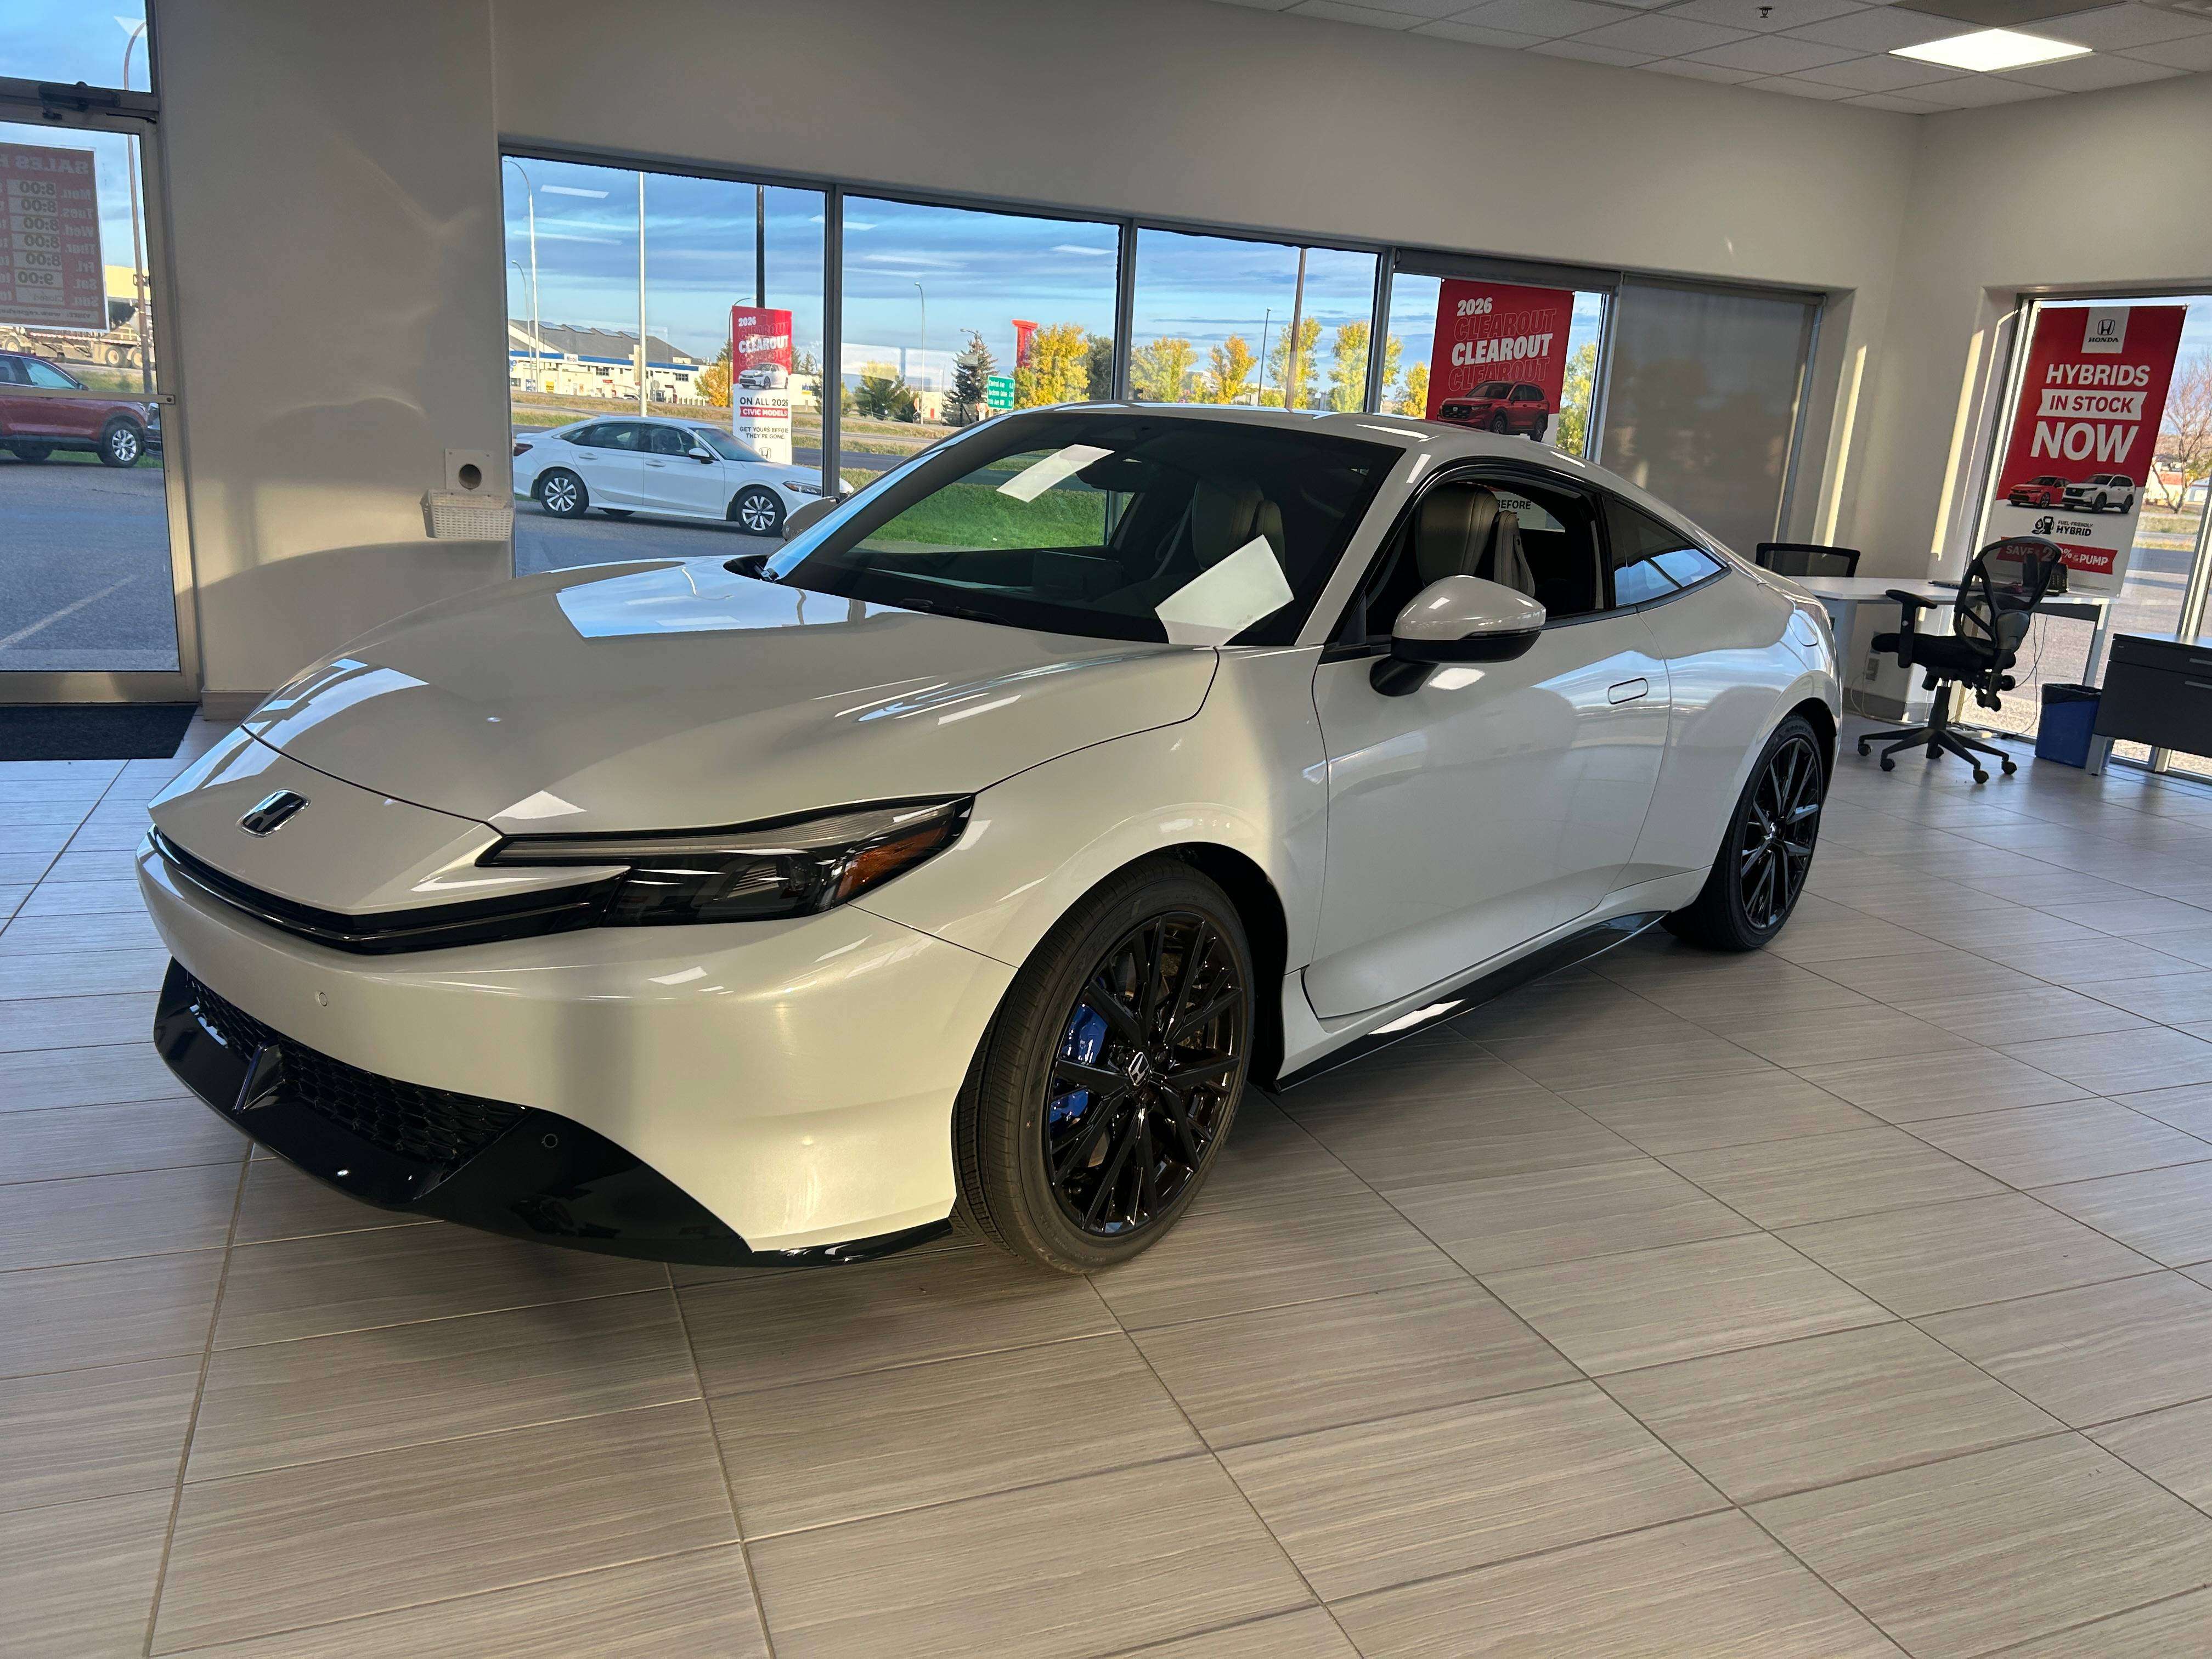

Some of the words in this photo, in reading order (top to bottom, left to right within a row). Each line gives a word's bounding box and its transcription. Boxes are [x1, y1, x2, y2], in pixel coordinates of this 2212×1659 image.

[1457, 297, 1493, 317] 2026
[738, 316, 757, 328] 2026
[1454, 308, 1557, 342] CLEAROUT
[738, 335, 789, 353] CLEAROUT
[1451, 333, 1553, 366] CLEAROUT
[1448, 357, 1550, 392] CLEAROUT
[2046, 364, 2151, 386] HYBRIDS
[740, 397, 753, 405] ON
[755, 398, 770, 406] ALL
[2049, 395, 2068, 410] IN
[2072, 396, 2134, 413] STOCK
[2030, 421, 2139, 463] NOW
[2056, 525, 2092, 537] HYBRID
[2005, 545, 2034, 556] SAVE
[2079, 554, 2108, 566] PUMP
